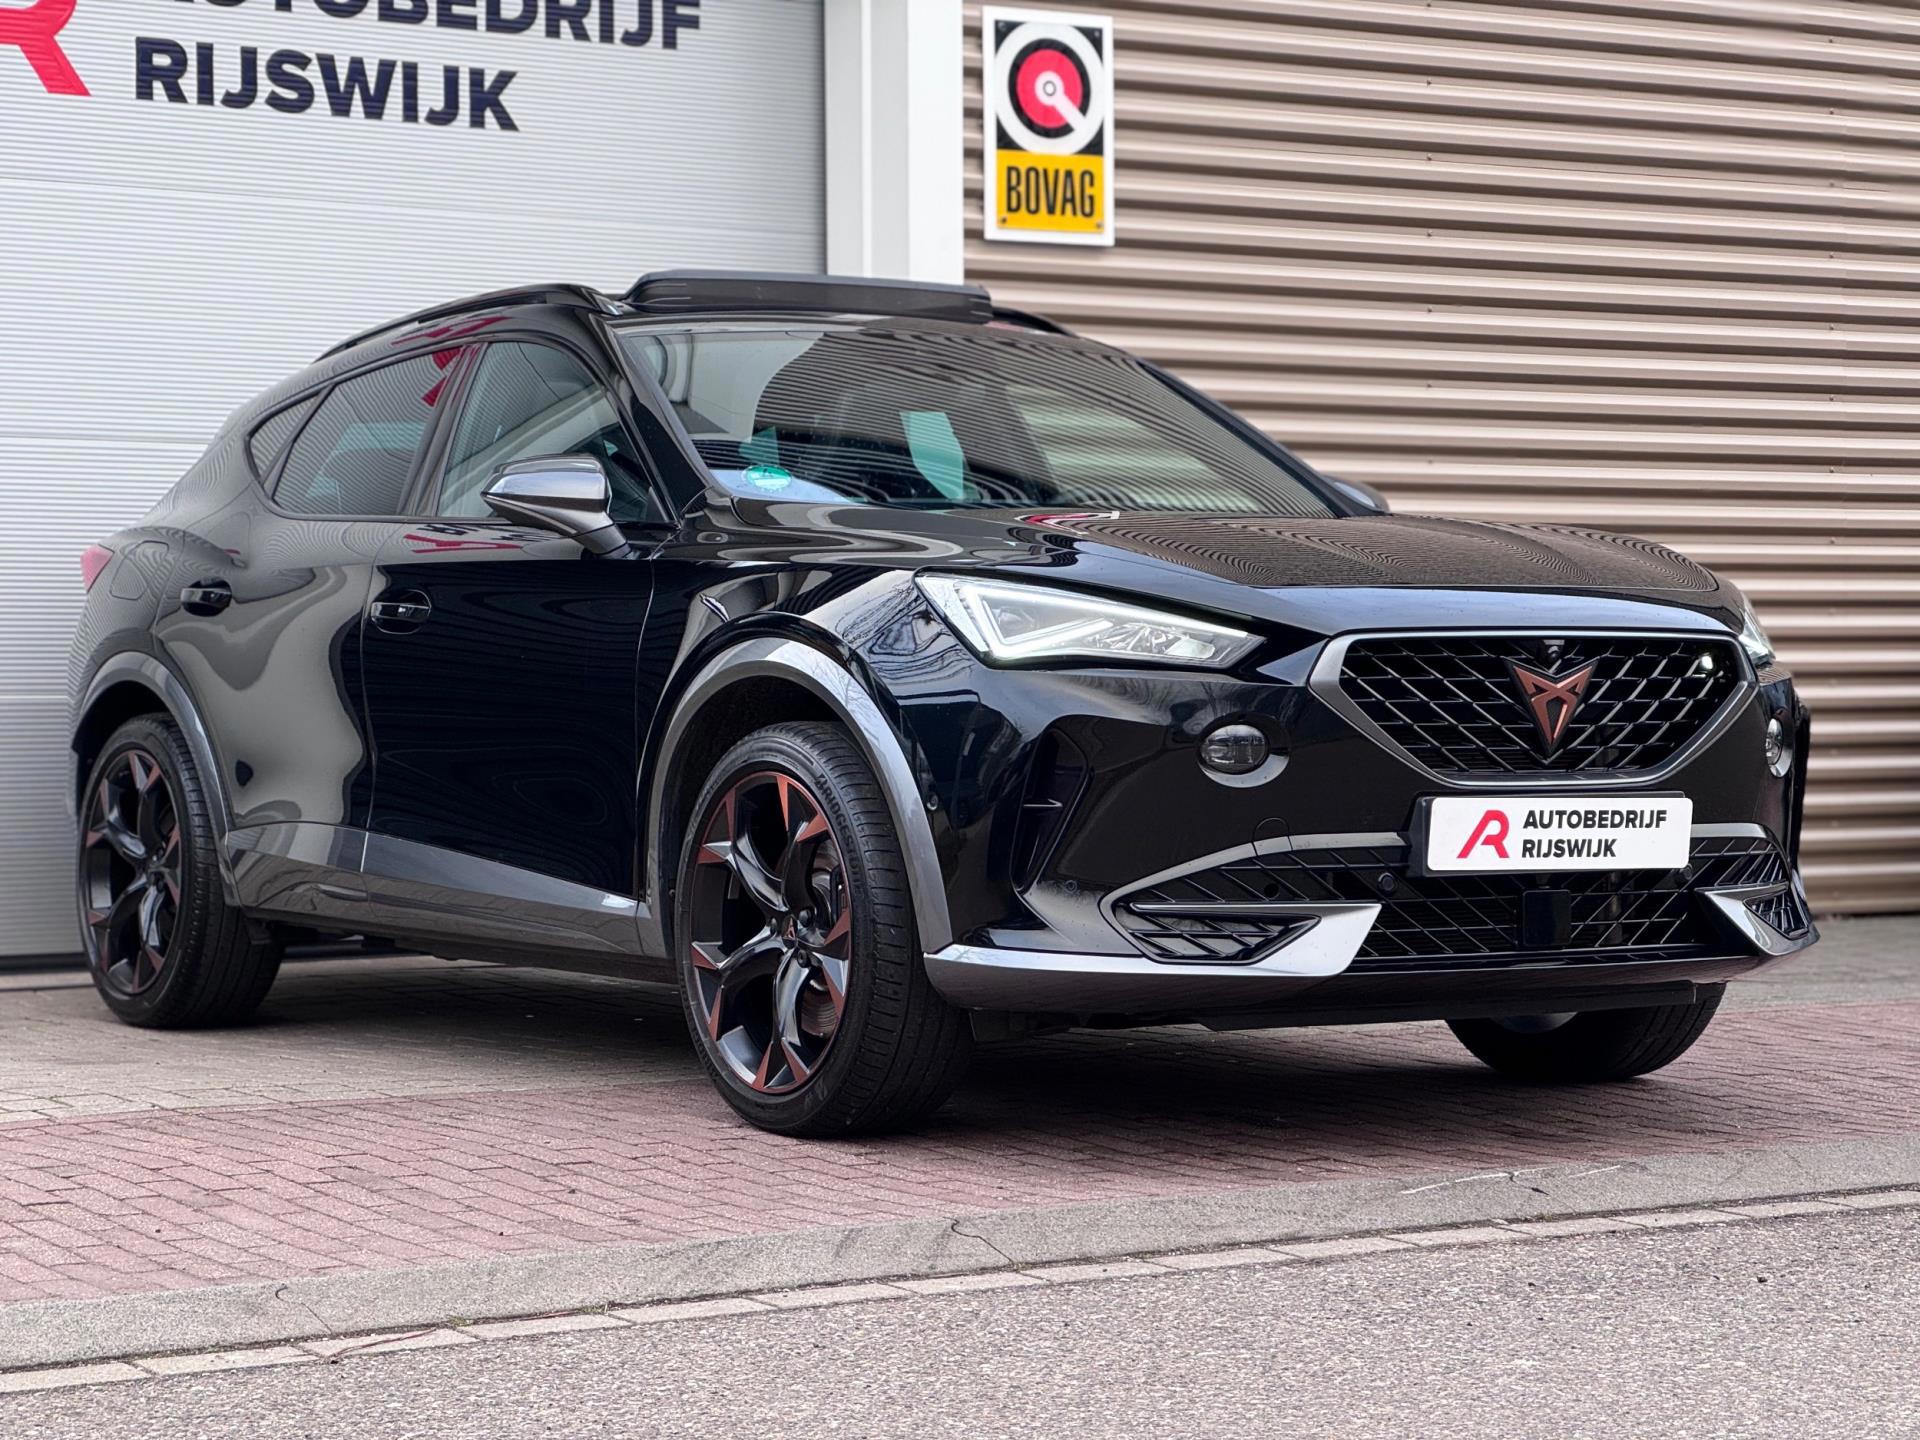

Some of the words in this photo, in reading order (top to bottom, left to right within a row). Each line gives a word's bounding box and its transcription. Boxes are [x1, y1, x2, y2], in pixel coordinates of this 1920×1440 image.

[174, 0, 700, 50] EDRIJF
[135, 36, 520, 131] RIJSWIJK
[1006, 165, 1095, 218] BOVAG
[1522, 809, 1667, 829] AUTOBEDRIJF
[1521, 838, 1618, 858] RIJSWIJK
